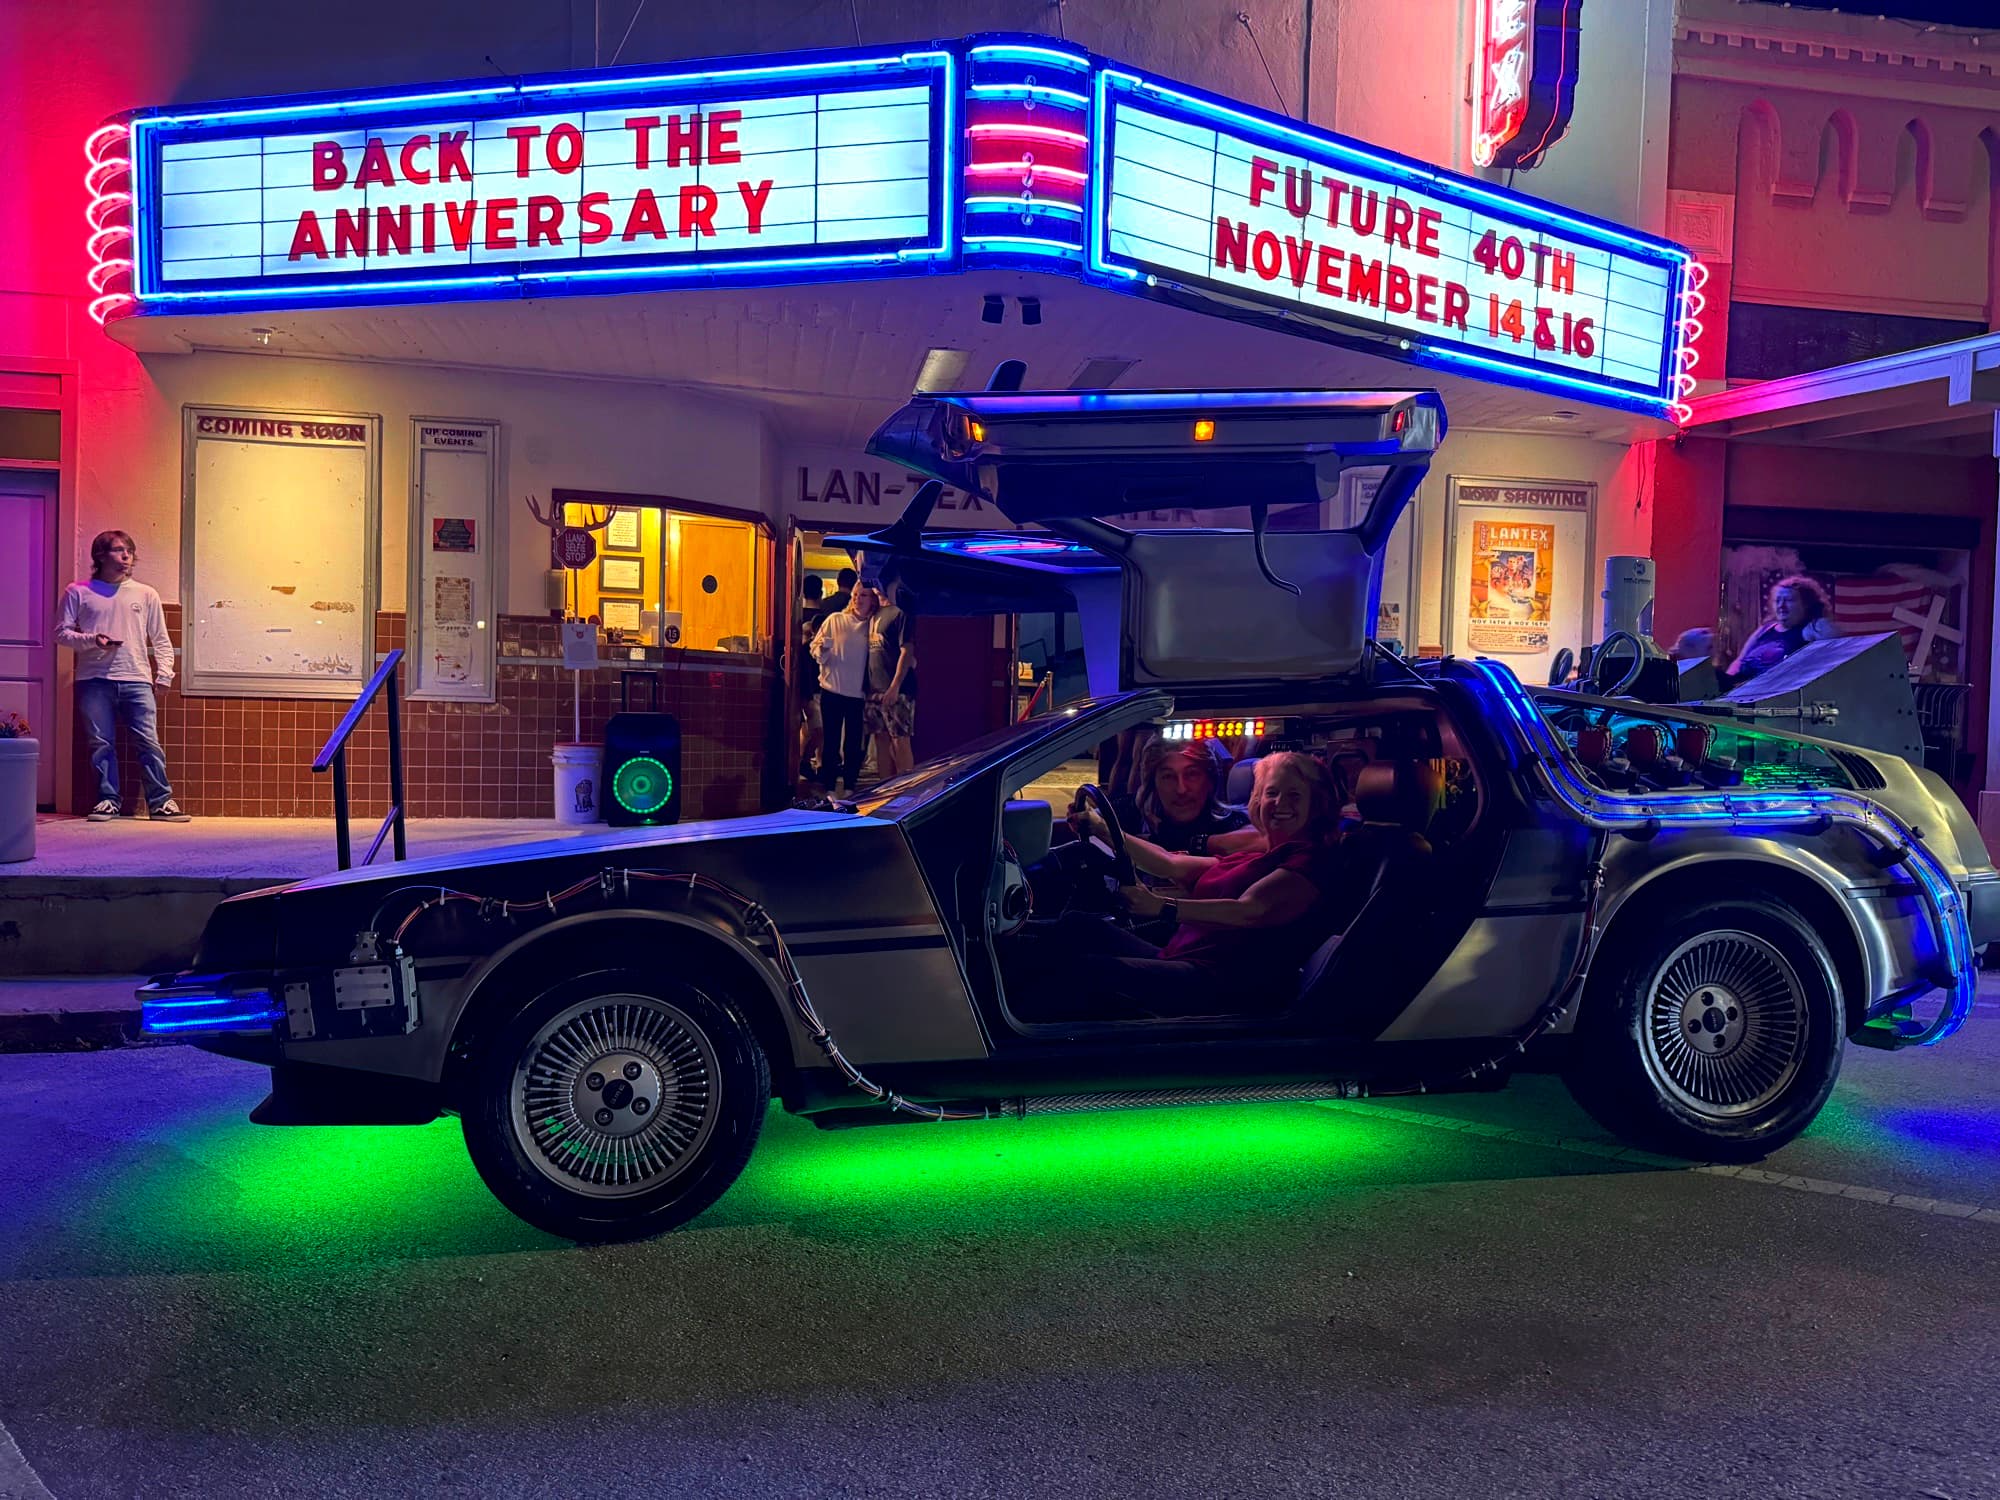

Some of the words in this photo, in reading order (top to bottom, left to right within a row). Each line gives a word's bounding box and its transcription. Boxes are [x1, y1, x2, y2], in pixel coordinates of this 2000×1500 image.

[312, 129, 475, 192] BACK
[507, 121, 585, 179] TO
[625, 110, 743, 170] THE
[288, 179, 774, 262] ANNIVERSARY
[1249, 155, 1442, 259] FUTURE
[1473, 228, 1575, 296] 40TH
[1215, 216, 1470, 331] NOVEMBER
[200, 417, 293, 437] COMING
[300, 422, 365, 441] SOON
[442, 429, 482, 438] COMING
[434, 437, 474, 446] EVENTS
[1460, 486, 1499, 501] NOW
[1503, 489, 1586, 506] SHOWING
[1490, 527, 1548, 541] LANTEX
[565, 552, 586, 562] STOP
